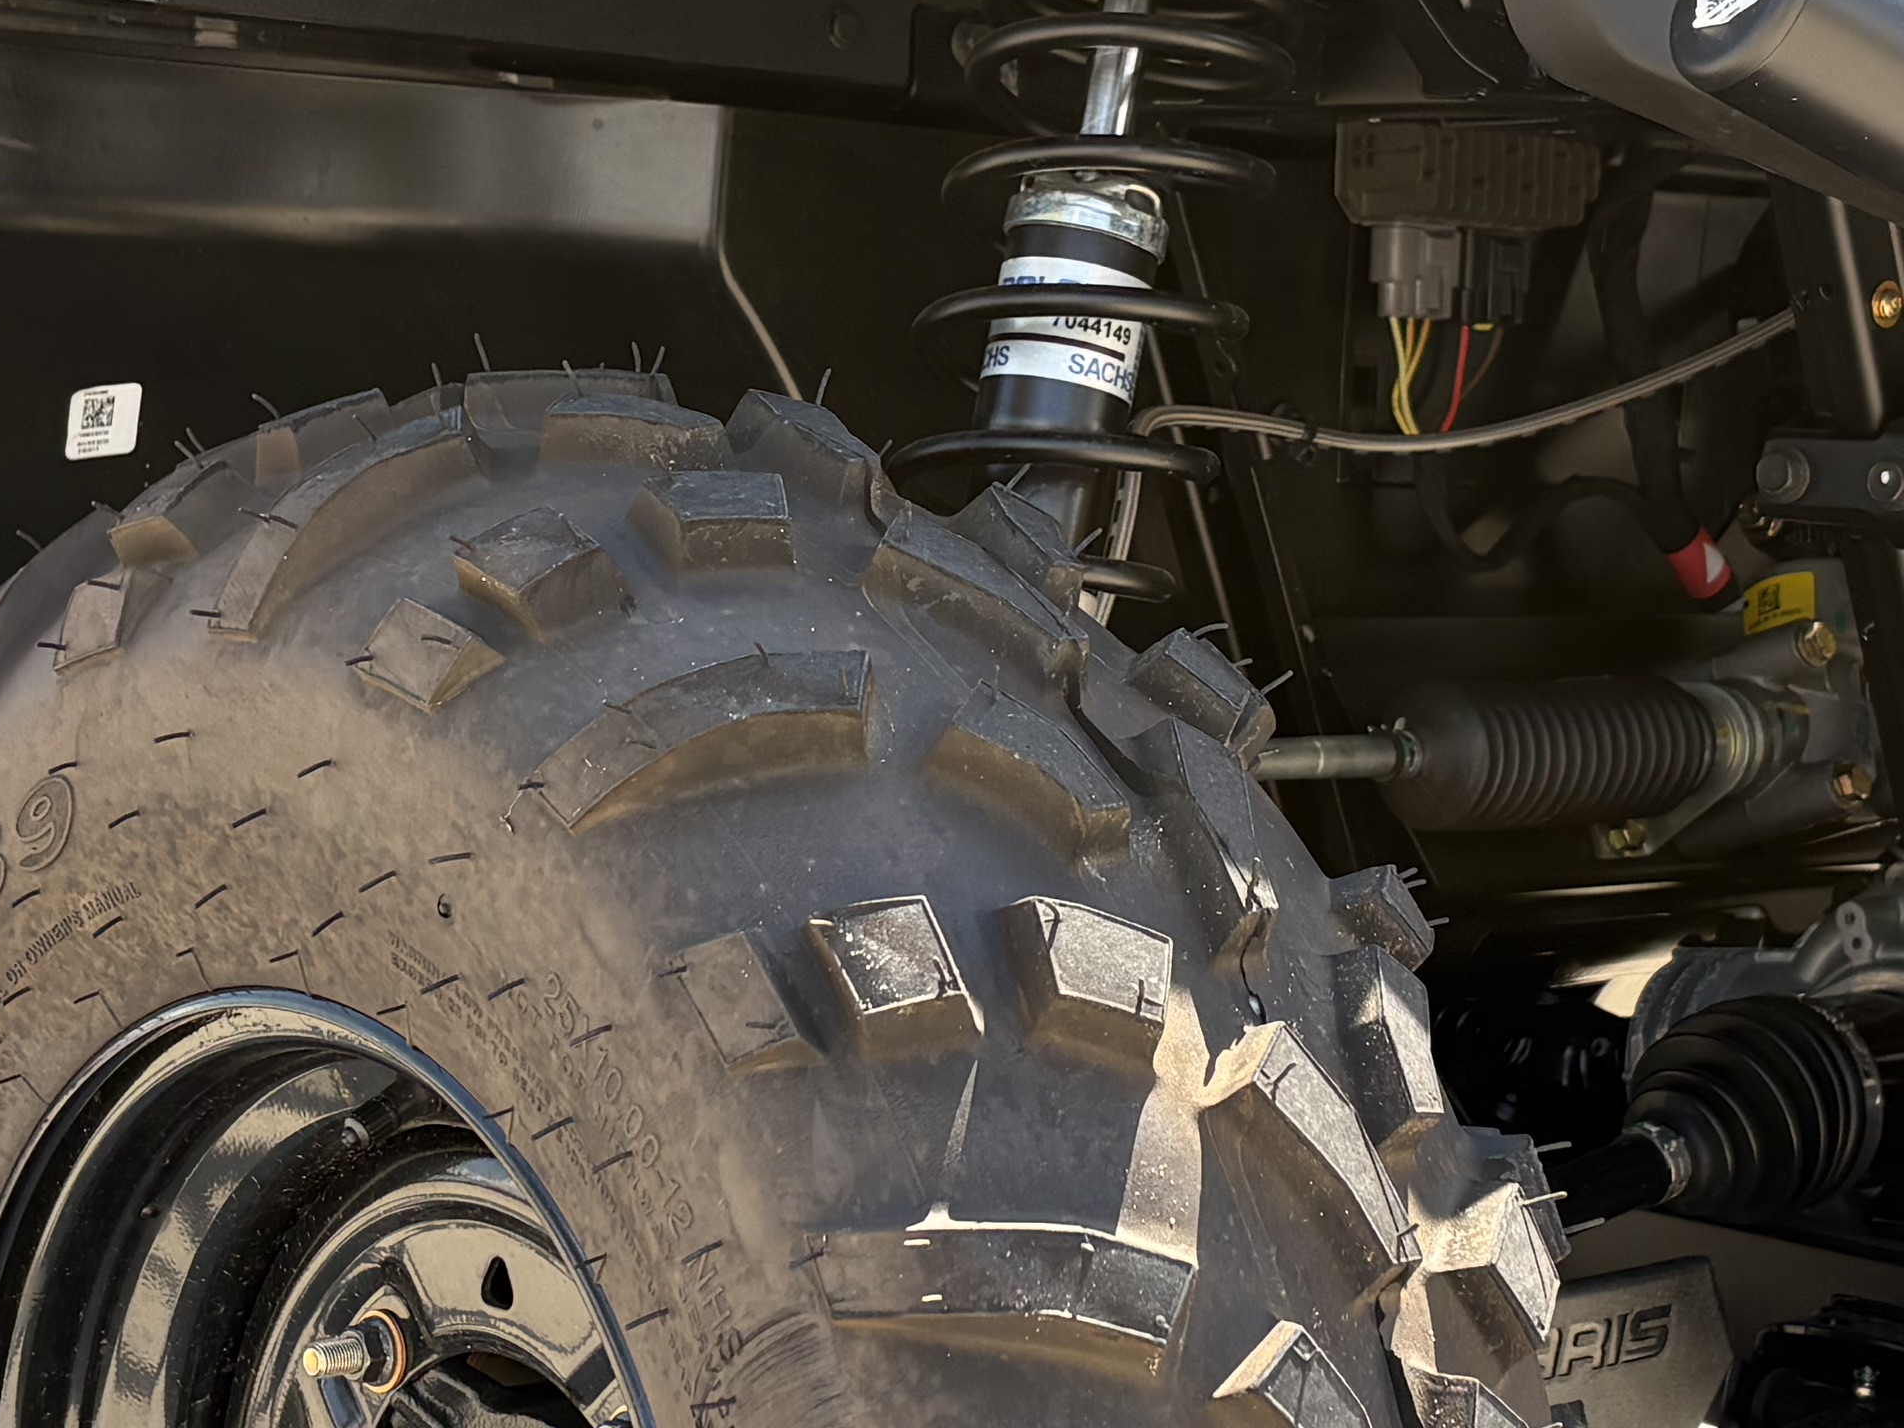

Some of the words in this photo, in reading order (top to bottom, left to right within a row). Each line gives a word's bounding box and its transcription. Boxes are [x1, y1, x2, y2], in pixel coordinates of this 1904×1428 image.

[1068, 353, 1134, 393] SACHS
[4, 955, 27, 989] OR
[26, 903, 82, 970] OWNER'S
[85, 875, 139, 924] MANUAL
[686, 1249, 744, 1363] NHS
